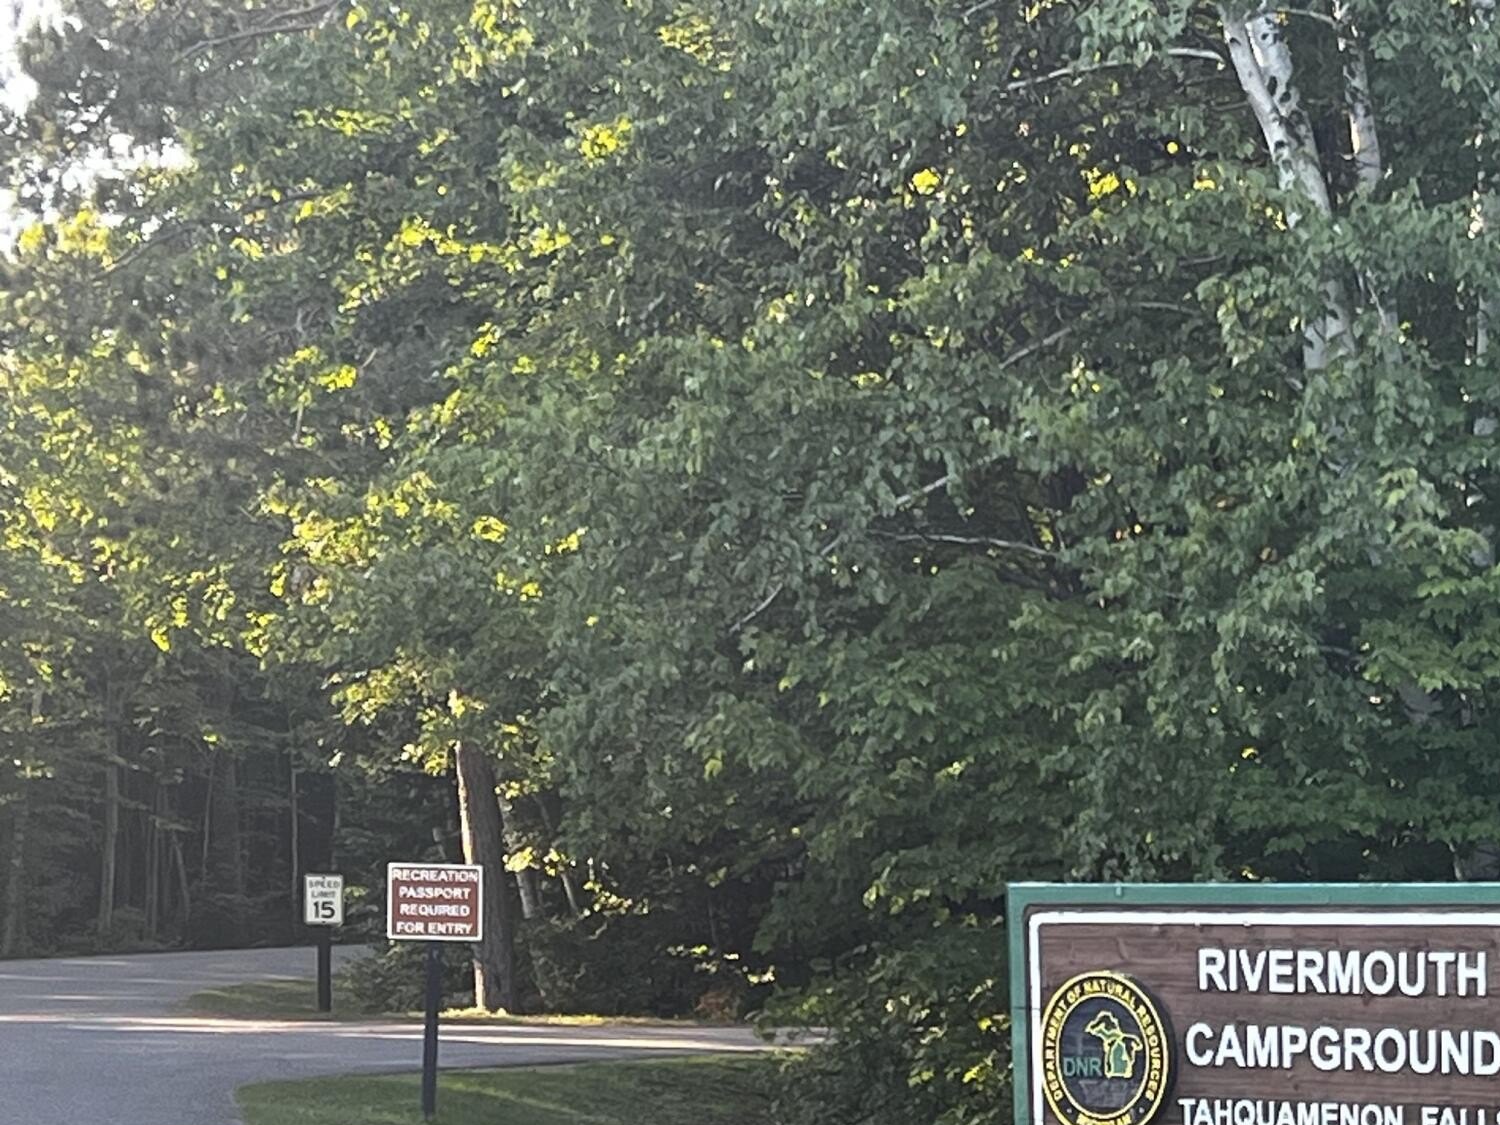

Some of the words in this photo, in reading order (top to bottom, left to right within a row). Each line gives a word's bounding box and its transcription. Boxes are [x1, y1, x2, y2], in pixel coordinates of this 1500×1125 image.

[392, 869, 479, 882] RECREATION
[399, 886, 471, 899] PASSPORT
[313, 901, 336, 919] 15
[400, 904, 471, 917] REQUIRED
[396, 922, 425, 934] FOR
[428, 922, 473, 935] ENTRY
[1198, 948, 1487, 997] RIVERMOUTH
[1066, 986, 1082, 1003] OF
[1083, 979, 1137, 1010] NATURAL
[1136, 1005, 1161, 1101] RESOURCES
[1063, 1056, 1103, 1077] DNR
